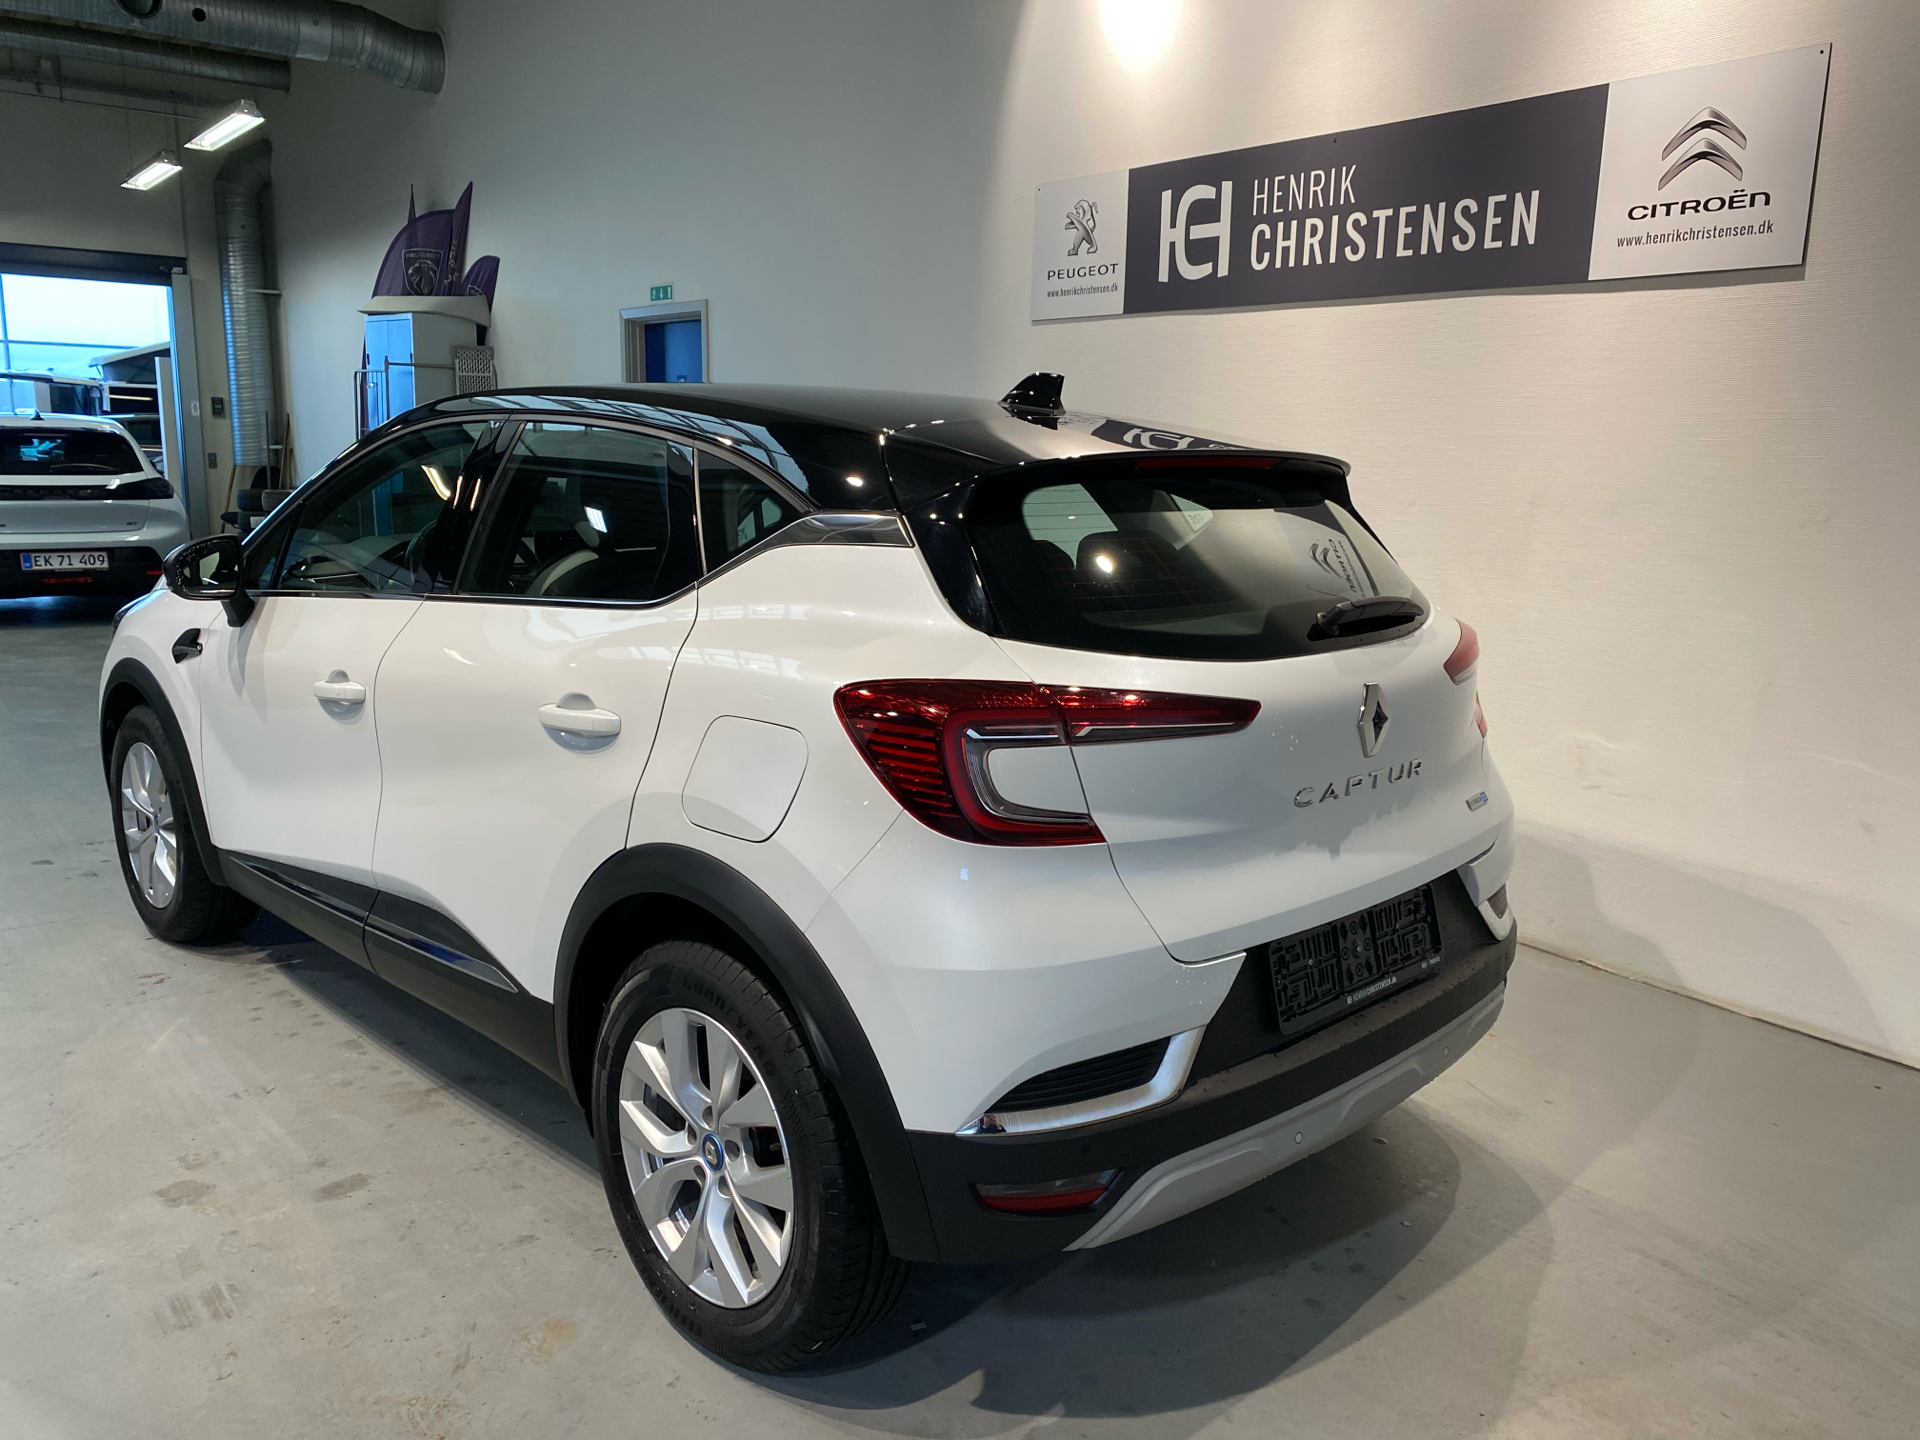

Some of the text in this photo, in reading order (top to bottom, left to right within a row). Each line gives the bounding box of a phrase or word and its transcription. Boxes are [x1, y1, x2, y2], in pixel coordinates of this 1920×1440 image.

[1253, 164, 1357, 216] HENRIK
[1250, 189, 1540, 271] CHRISTENSEN
[1617, 220, 1774, 247] www.henrikchristensen.dk
[1046, 262, 1119, 281] PEUGEOT
[1046, 282, 1119, 298] www.henrikchristensen.dk
[33, 555, 54, 567] EK
[56, 554, 74, 566] 71
[79, 553, 105, 566] 409
[1293, 758, 1422, 808] CAPTUR
